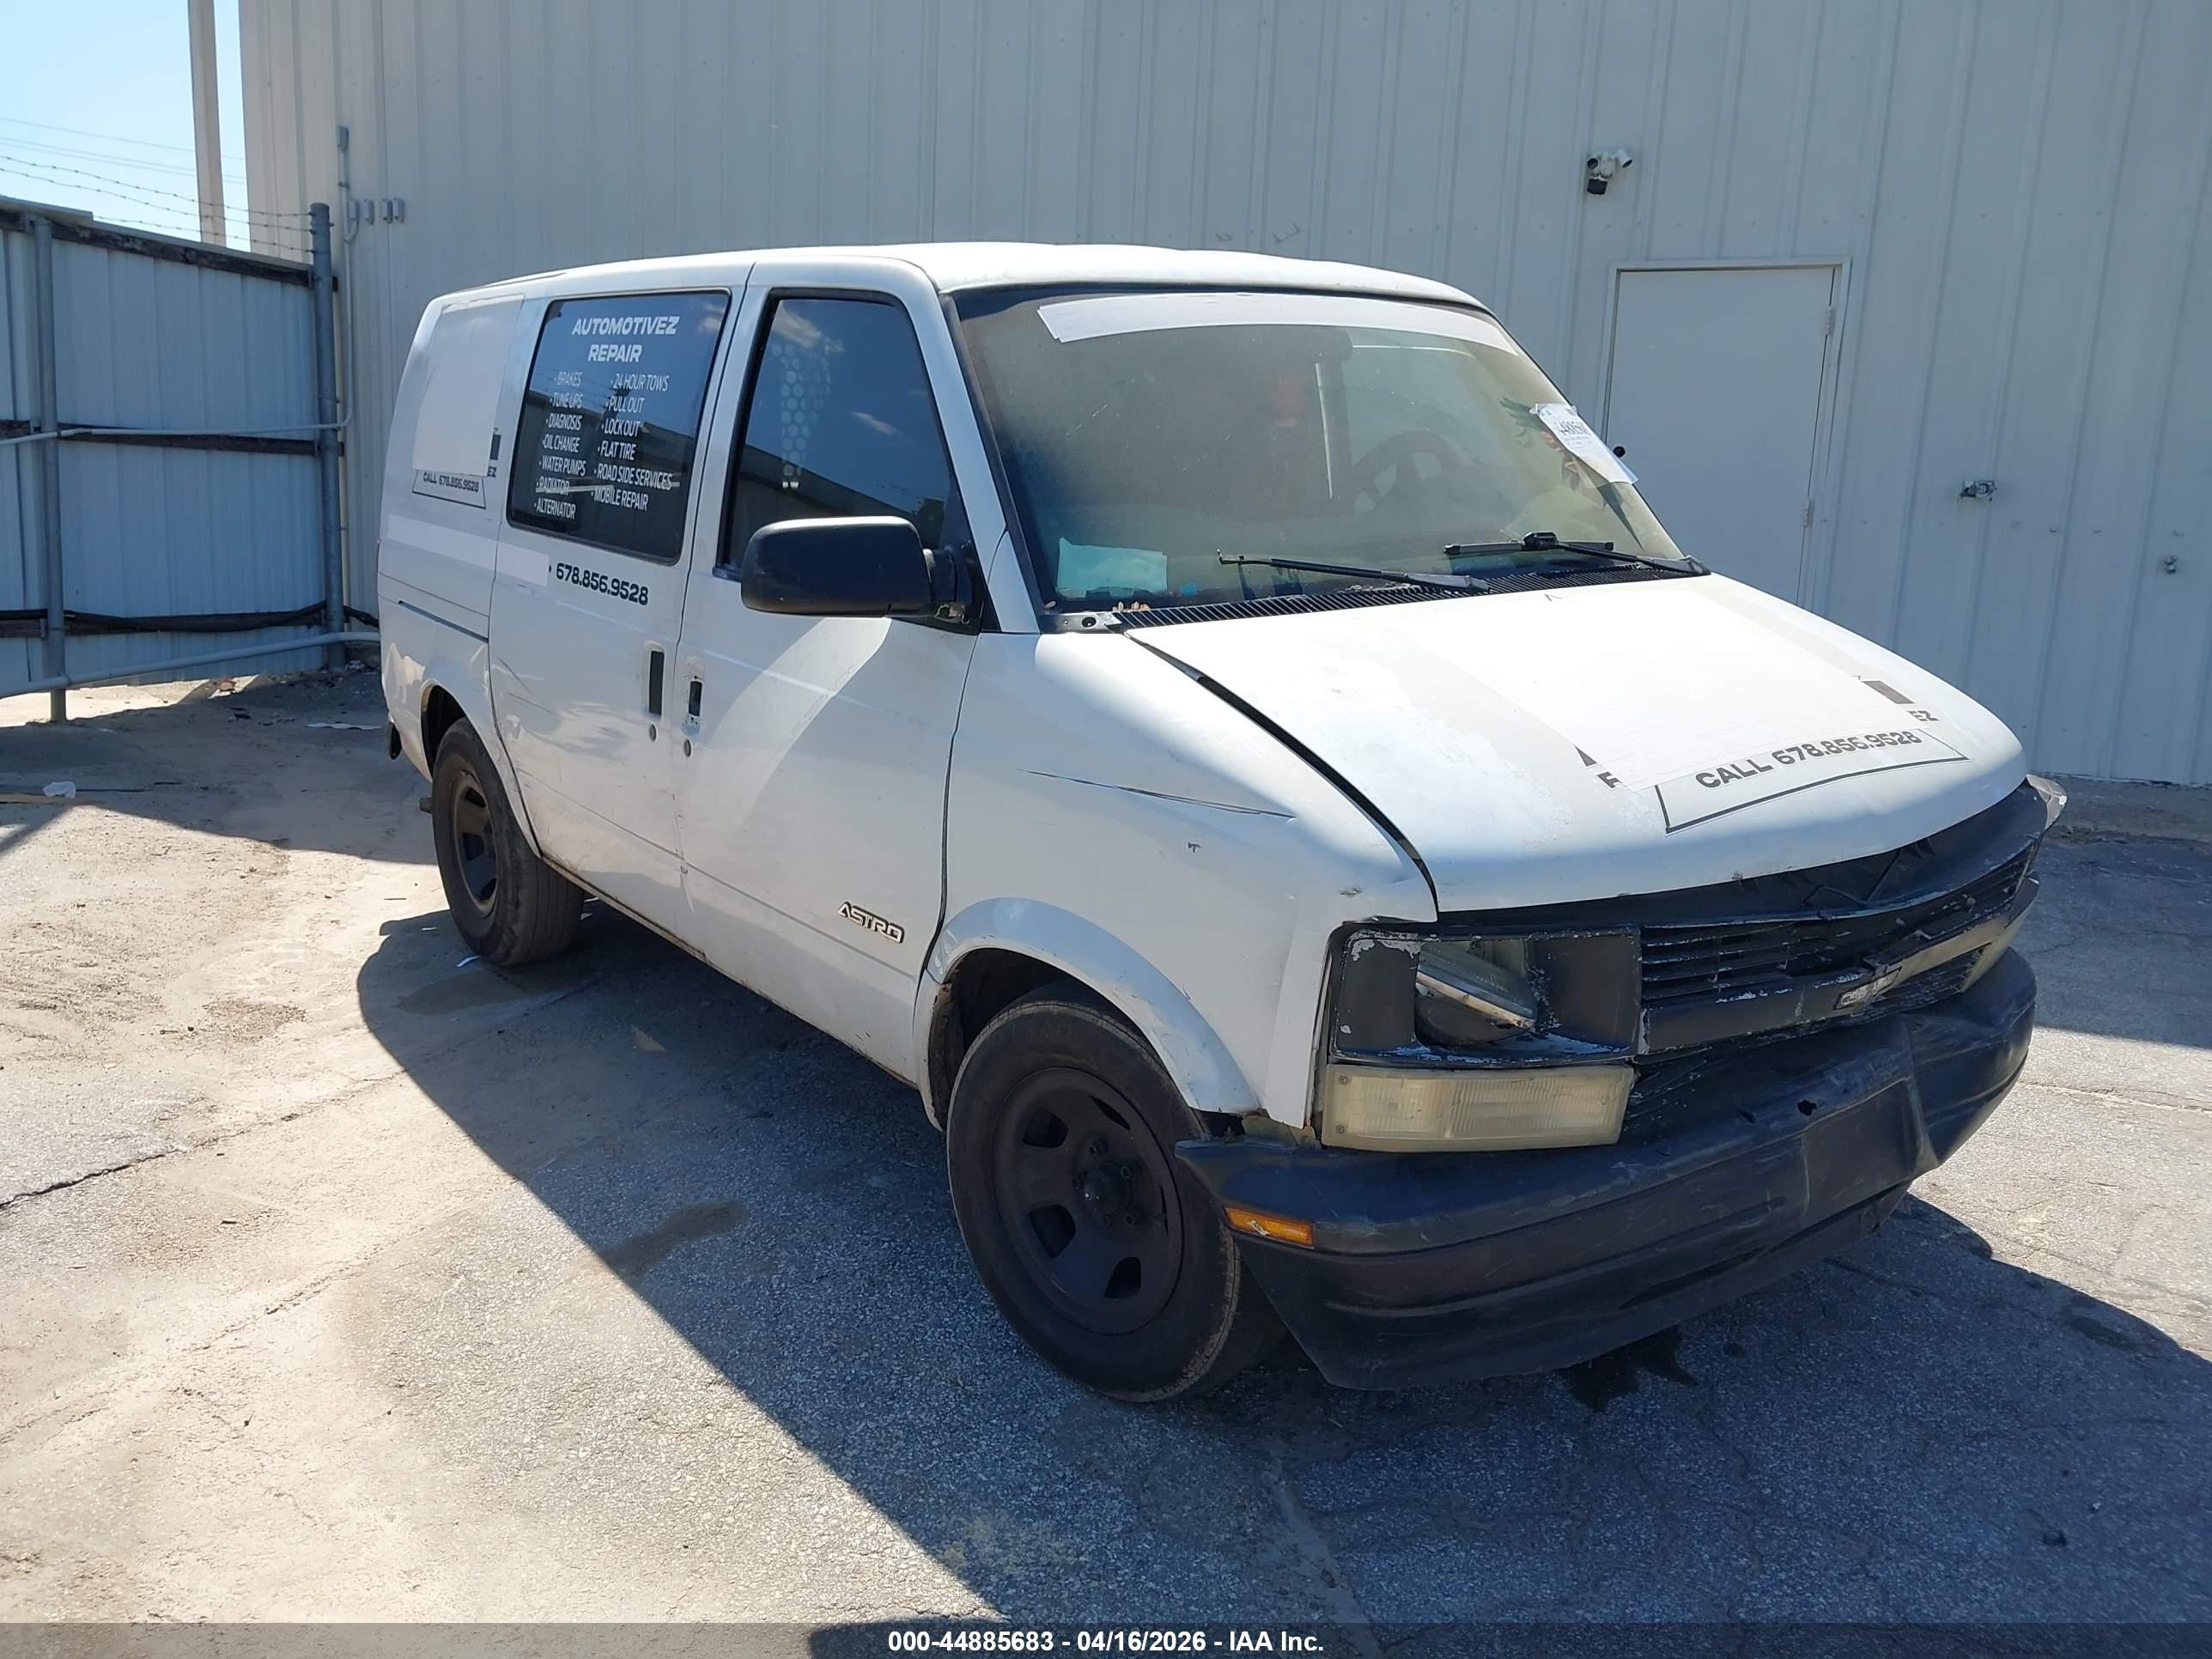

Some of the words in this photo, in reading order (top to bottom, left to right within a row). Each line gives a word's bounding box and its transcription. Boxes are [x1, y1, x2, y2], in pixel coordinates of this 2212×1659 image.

[571, 316, 680, 336] AUTOMOTIVEZ
[587, 343, 642, 362] REPAIR
[613, 373, 624, 389] 24
[623, 374, 646, 391] HOUR
[646, 374, 670, 392] TOWS
[608, 395, 627, 412] PULL
[627, 397, 646, 413] OUT
[548, 413, 583, 431] DIAGNOSIS
[604, 418, 624, 435] LOCK
[623, 420, 641, 437] OUT
[553, 434, 580, 453] CHANGE
[600, 440, 620, 459] FLAT
[618, 442, 637, 460] TIRE
[542, 455, 563, 472] WATER
[562, 458, 587, 477] PUMPS
[597, 463, 618, 481] ROAD
[617, 465, 635, 484] SIDE
[635, 468, 672, 490] SERVICES
[536, 497, 576, 520] ALTERNATOR
[593, 486, 623, 507] MOBILE
[621, 490, 649, 511] REPAIR
[556, 562, 649, 606] 678.856.9528
[1695, 758, 1774, 788] CALL
[1771, 730, 1923, 765] 678.856.9528
[837, 900, 905, 944] ASTRO
